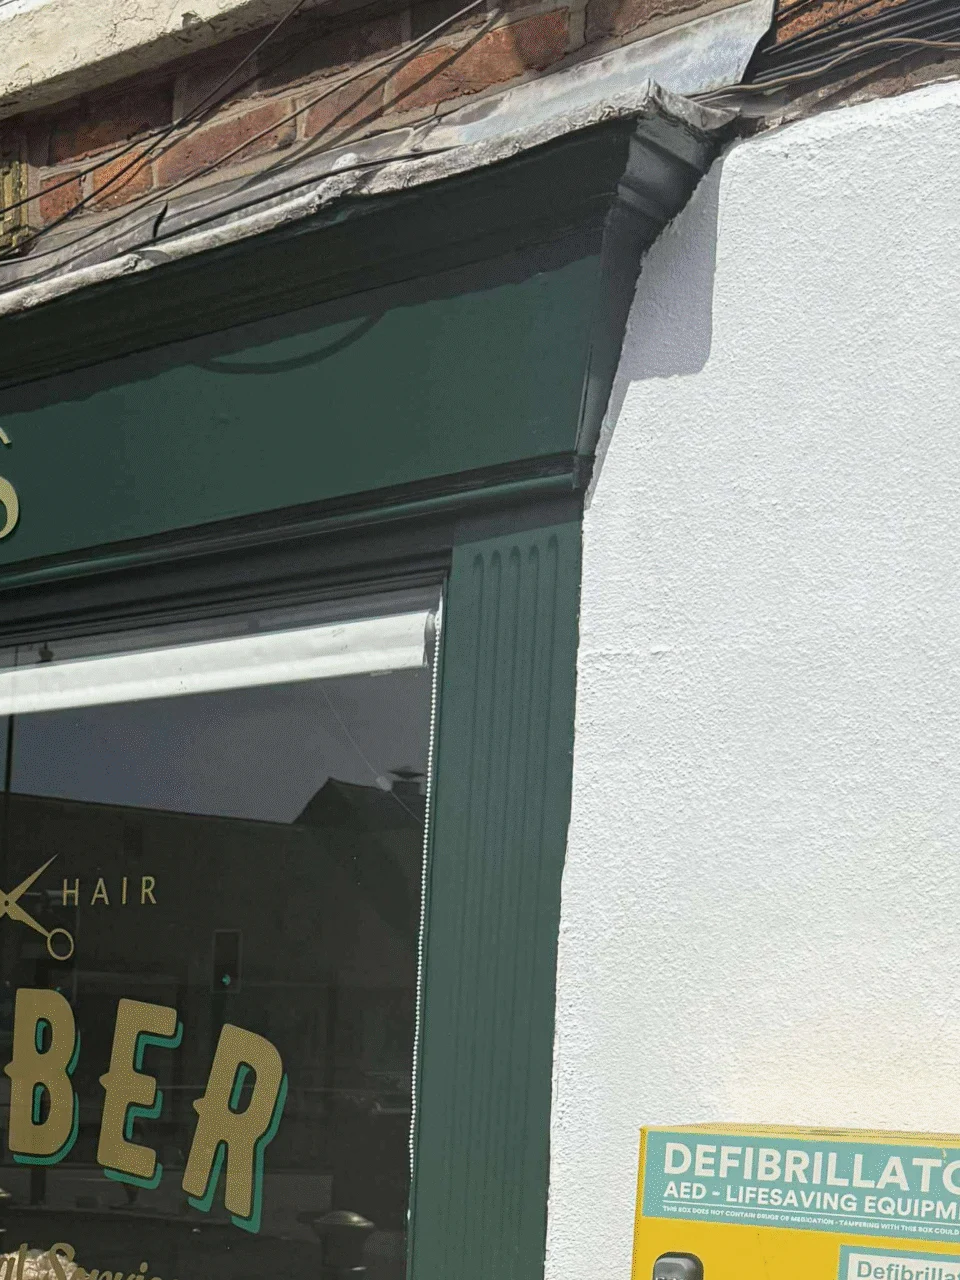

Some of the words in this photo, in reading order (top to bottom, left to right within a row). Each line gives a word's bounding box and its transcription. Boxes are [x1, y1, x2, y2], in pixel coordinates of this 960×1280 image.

[62, 875, 158, 906] HAIR
[663, 1180, 707, 1200] AED
[726, 1184, 858, 1212] LIFESAVING
[863, 1195, 960, 1221] EQUIPM
[662, 1205, 677, 1213] THIS
[678, 1206, 692, 1214] BOX
[692, 1207, 709, 1215] DOES
[725, 1210, 756, 1219] CONTAIN
[790, 1216, 834, 1226] MEDICATION
[839, 1220, 880, 1229] TAMPERING
[881, 1223, 900, 1231] WITH
[900, 1224, 917, 1232] THIS
[918, 1226, 933, 1234] BOX
[934, 1227, 960, 1235] COULD
